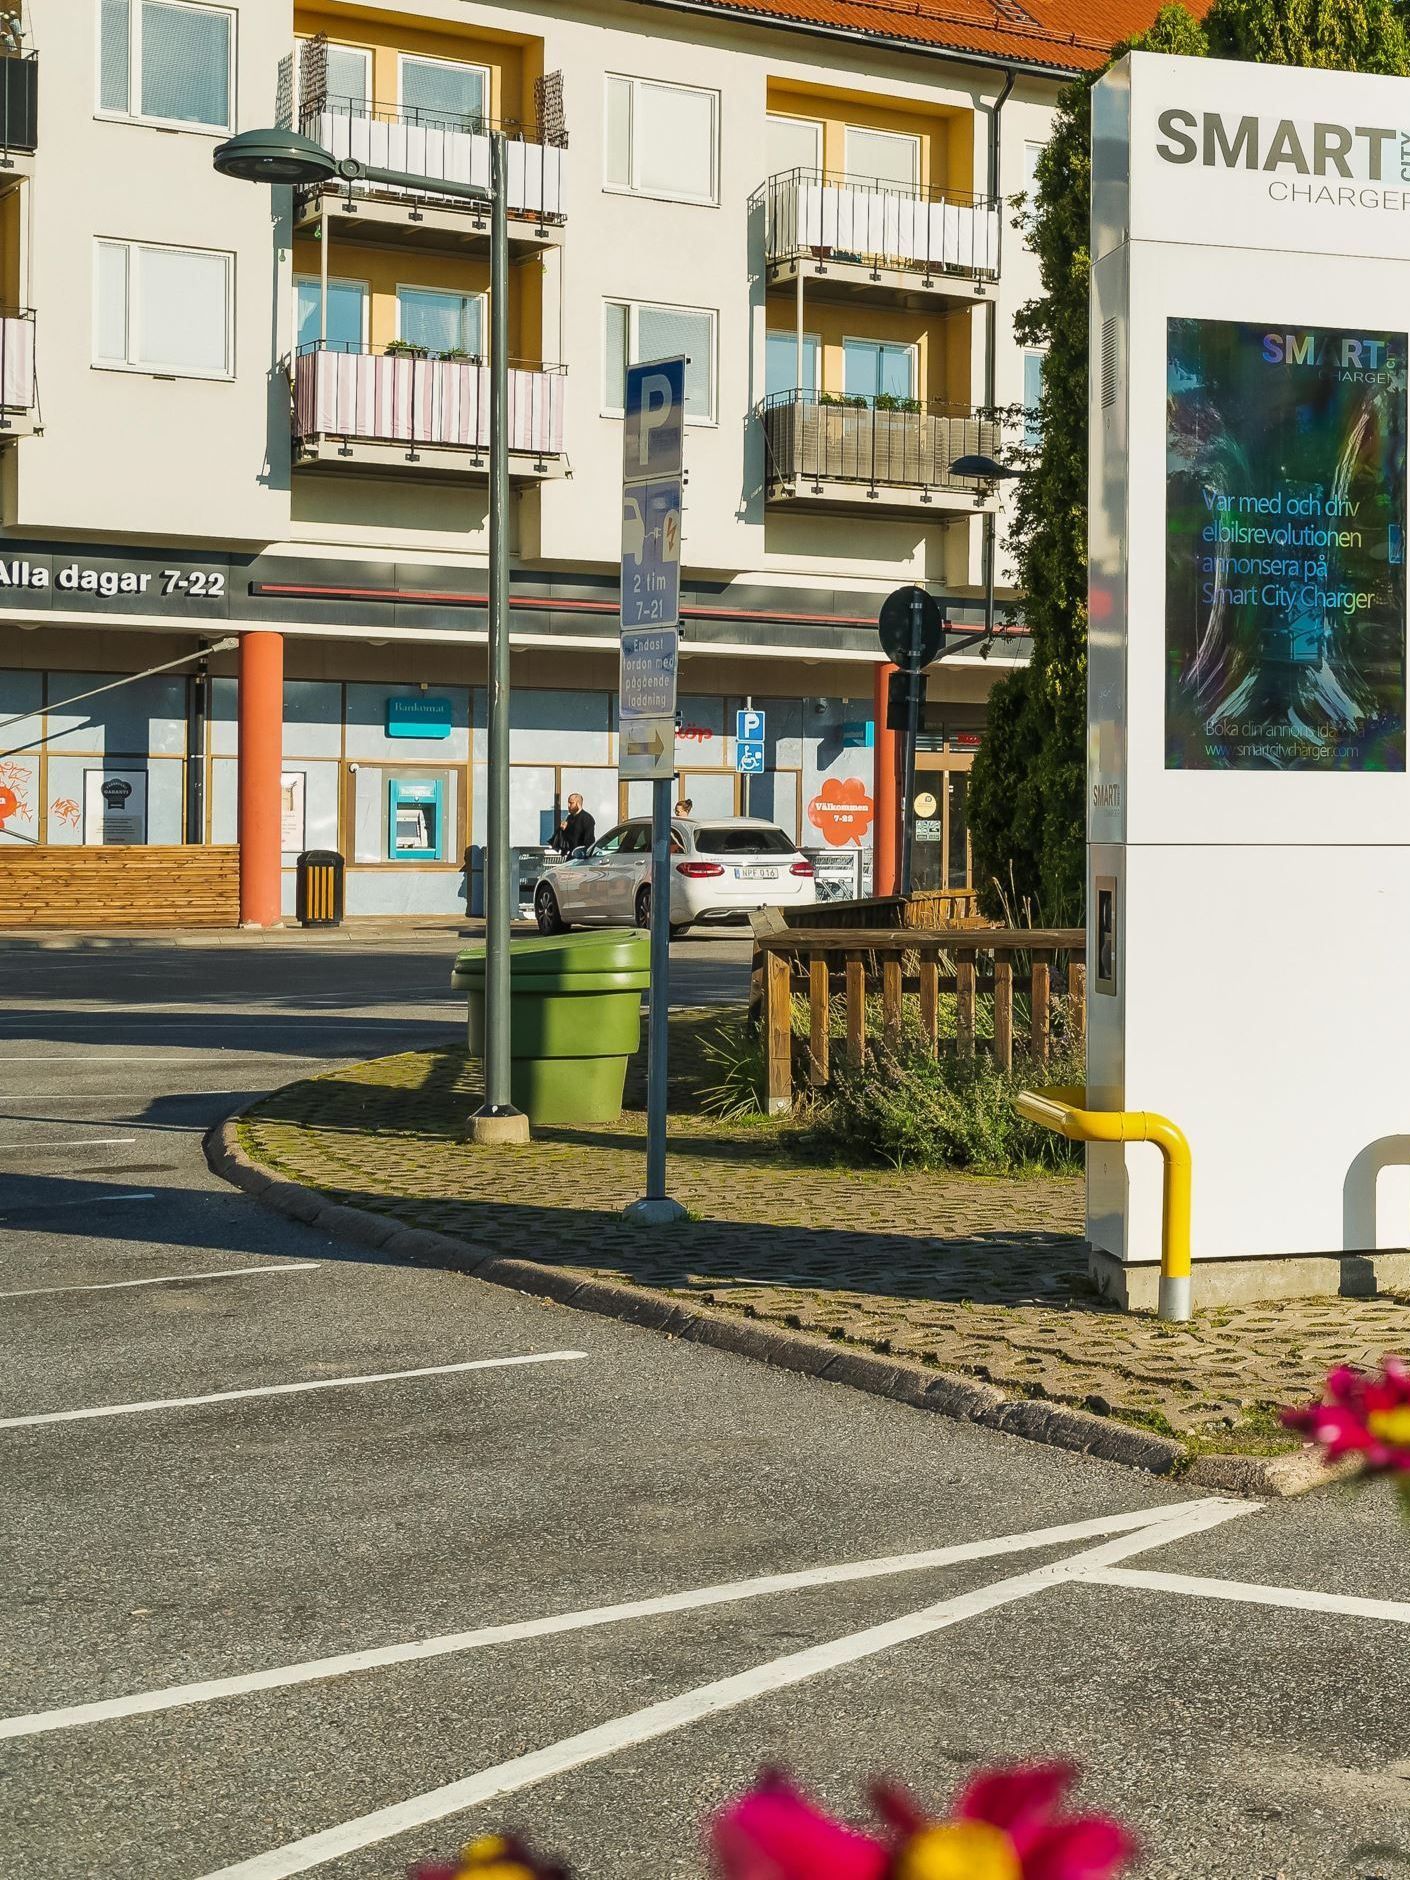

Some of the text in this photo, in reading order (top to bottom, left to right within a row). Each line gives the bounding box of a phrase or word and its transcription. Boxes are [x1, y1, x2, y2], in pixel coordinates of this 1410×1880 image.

[1155, 108, 1397, 181] SMART
[639, 373, 673, 466] P
[1202, 489, 1360, 517] Var med och driv
[1202, 520, 1362, 548] elbilsrevolutionen
[0, 559, 225, 596] Alla dagar 7-22
[1202, 554, 1328, 582] annonsera på
[633, 572, 666, 593] 2 tim
[636, 599, 663, 620] 7-21
[1202, 582, 1375, 615] Smart City Charger
[633, 638, 664, 652] Endast
[655, 656, 674, 669] med
[625, 675, 670, 691] pågående
[394, 701, 445, 713] Bankomat
[628, 693, 666, 708] laddning
[744, 713, 760, 738] P
[1205, 720, 1239, 736] Boka
[1241, 721, 1263, 737] din
[1317, 722, 1345, 740] ida
[1093, 784, 1118, 807] SMART
[815, 802, 869, 812] Välkommen
